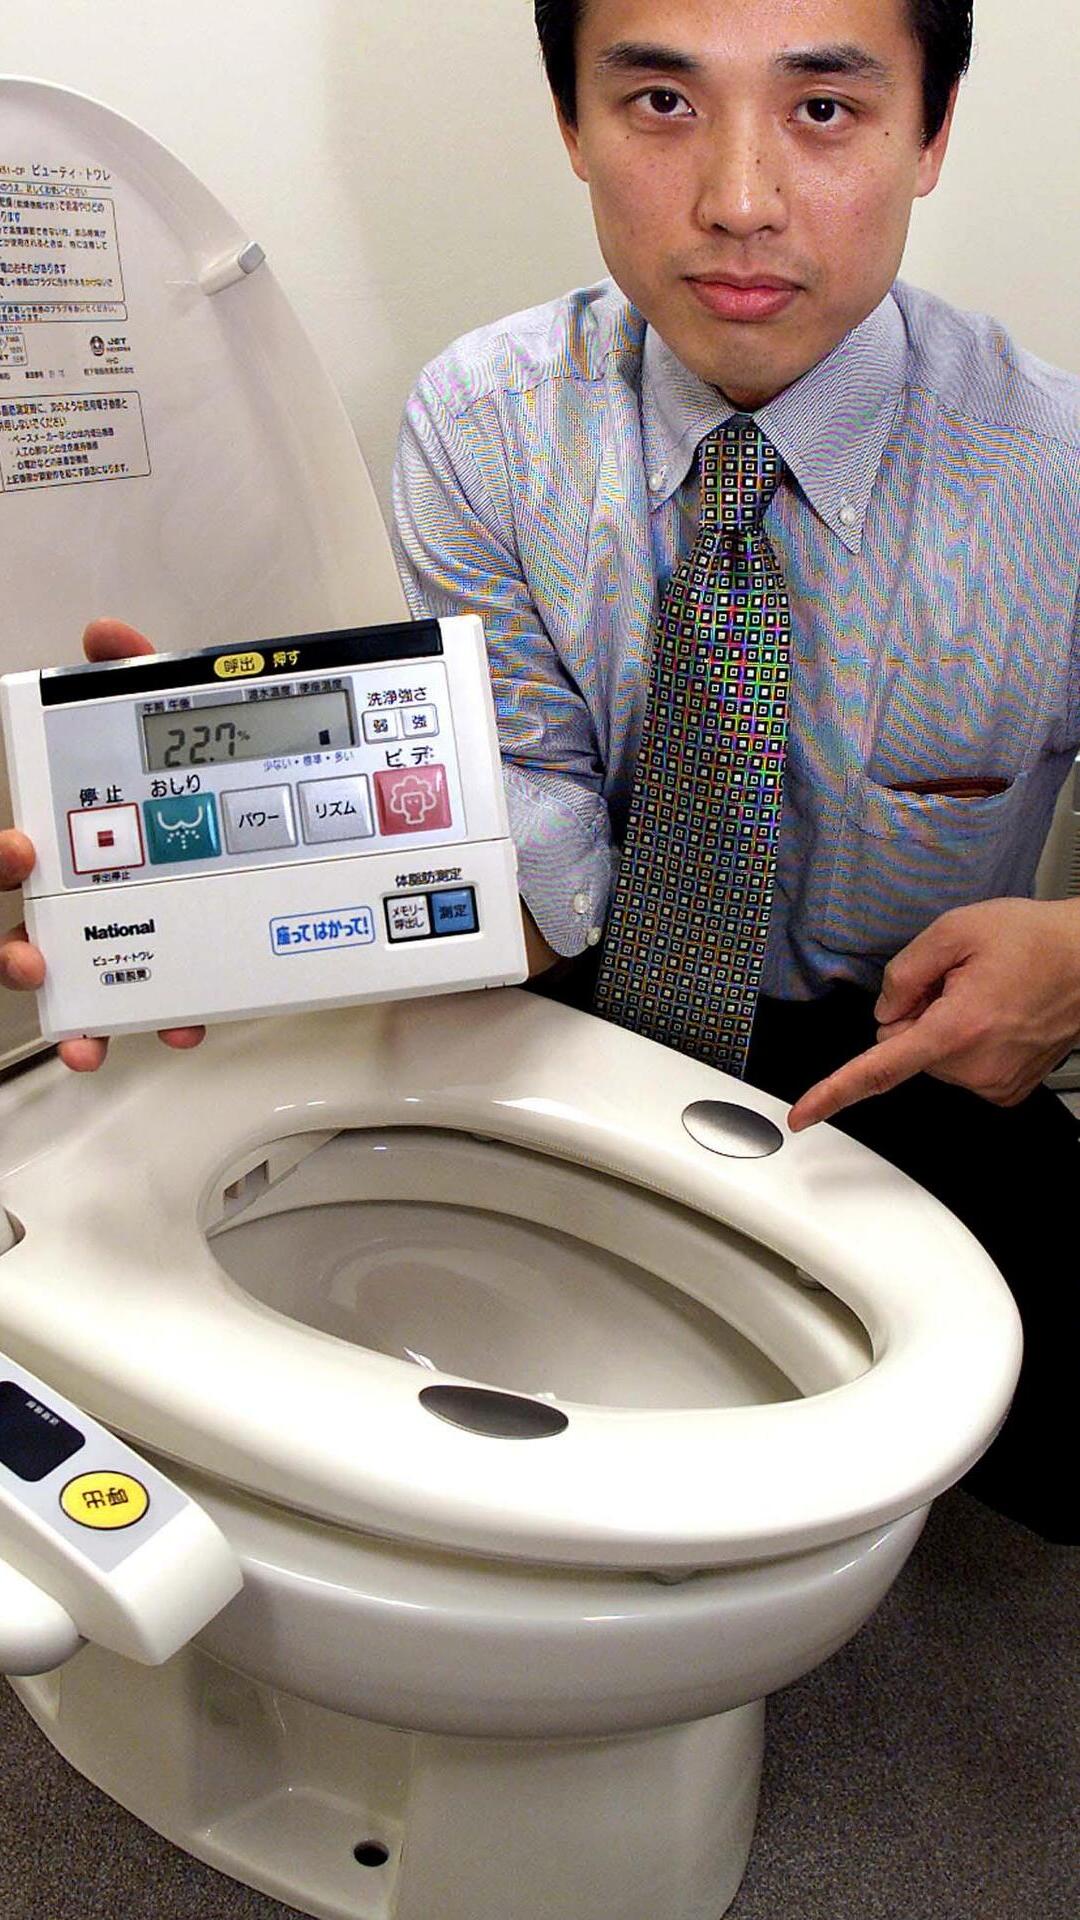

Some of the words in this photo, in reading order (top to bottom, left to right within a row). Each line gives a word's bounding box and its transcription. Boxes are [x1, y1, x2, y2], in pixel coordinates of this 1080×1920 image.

[223, 656, 255, 674] 呼出
[272, 650, 300, 668] 押す
[367, 687, 428, 707] 洗浄強さ
[385, 745, 435, 768] ビデ
[79, 784, 124, 807] 停止
[151, 774, 201, 798] おしり
[238, 811, 280, 828] パワー
[316, 800, 357, 819] リズム
[394, 867, 464, 888] 体脂肪測定
[391, 903, 425, 919] メモリー
[439, 903, 469, 920] 測定
[84, 918, 156, 941] National
